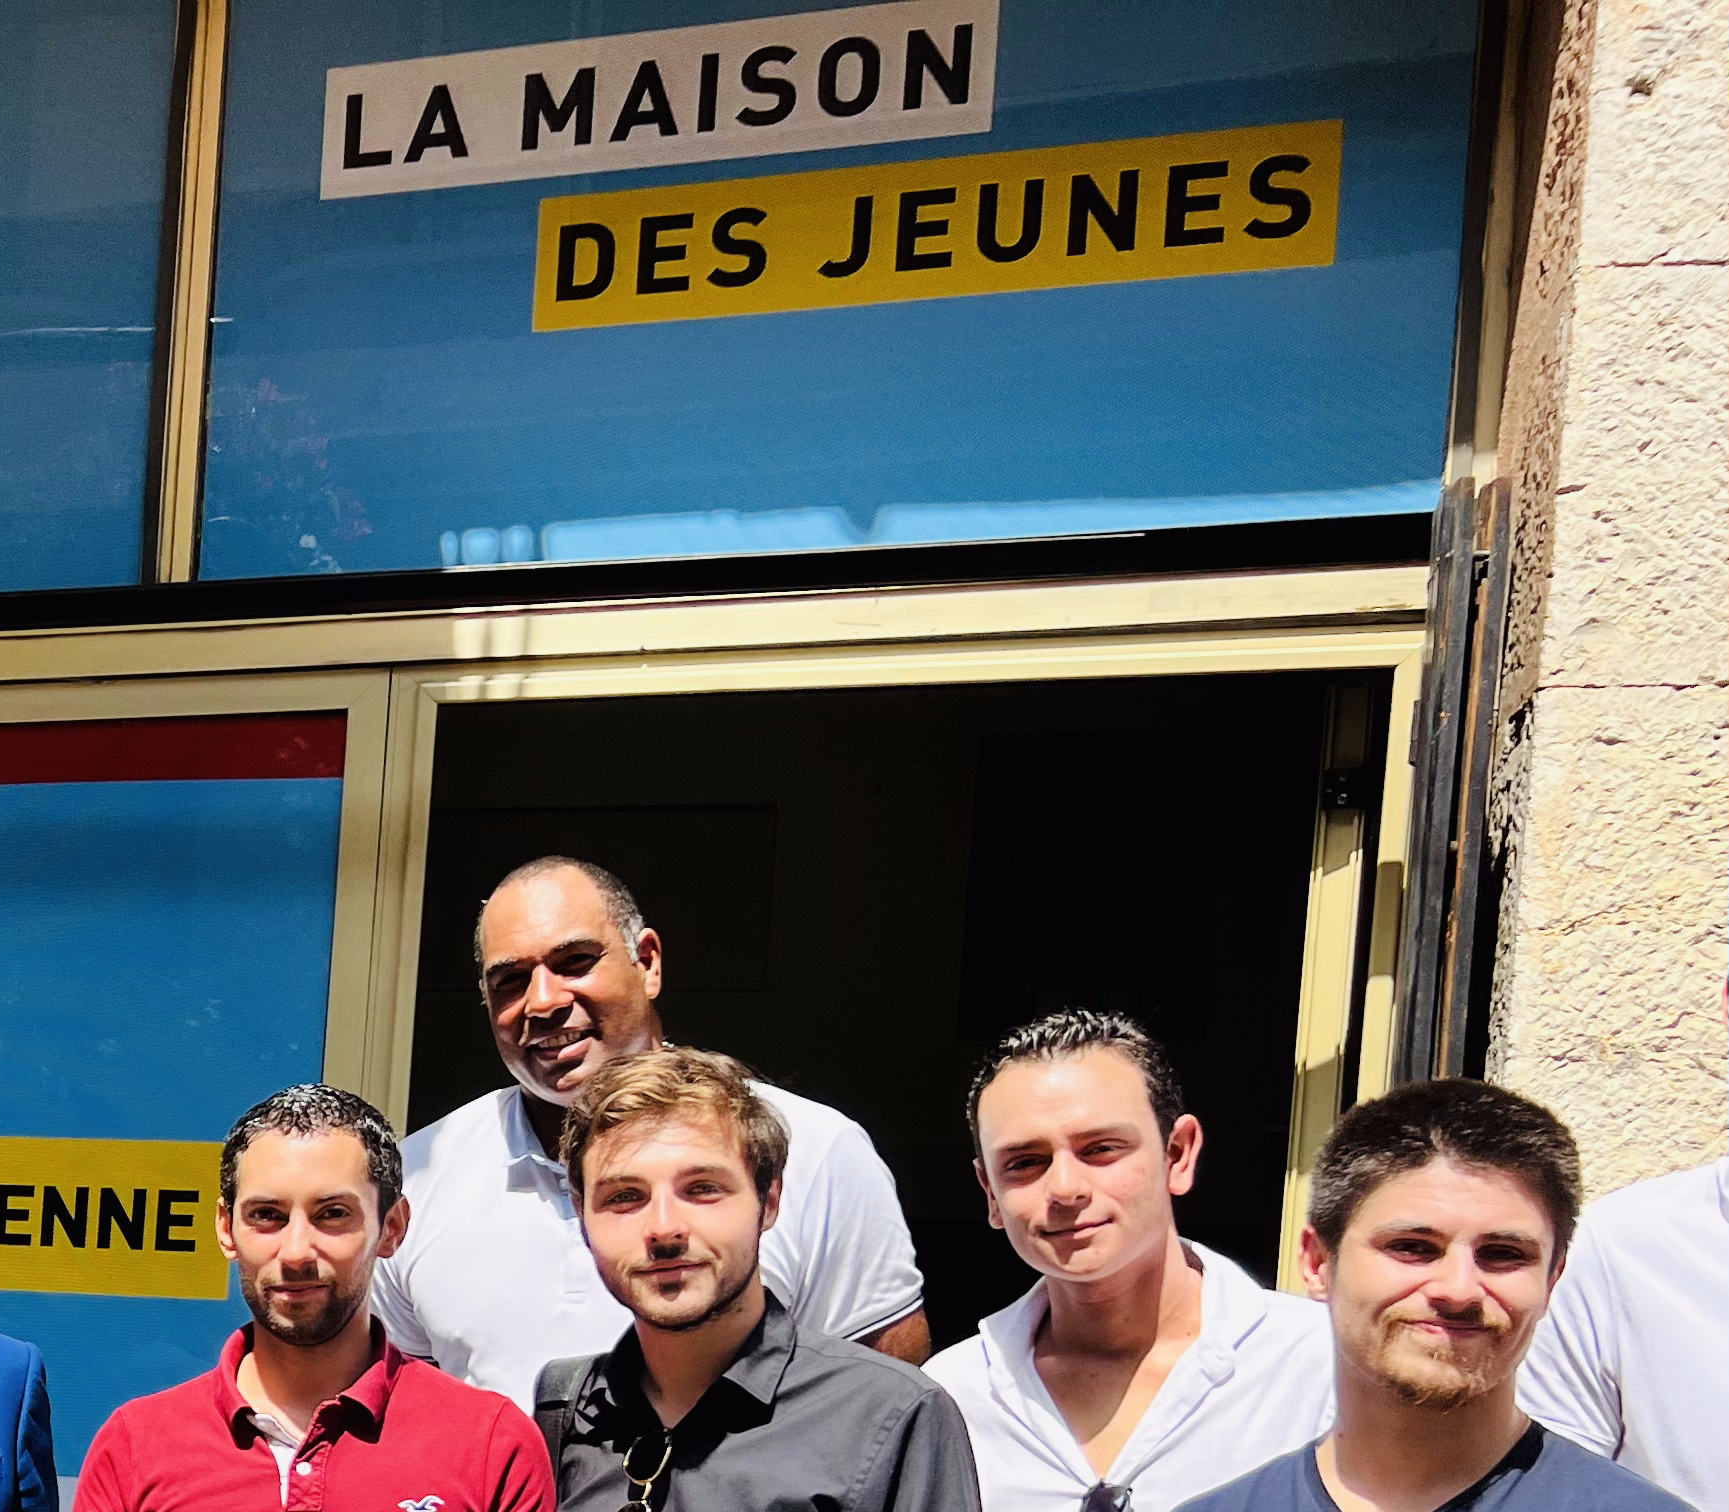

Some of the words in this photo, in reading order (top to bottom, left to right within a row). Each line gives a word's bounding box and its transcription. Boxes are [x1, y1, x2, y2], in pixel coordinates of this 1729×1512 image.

[343, 84, 469, 170] LA
[521, 22, 974, 152] MAISON
[555, 207, 769, 302] DES
[817, 155, 1313, 278] JEUNES
